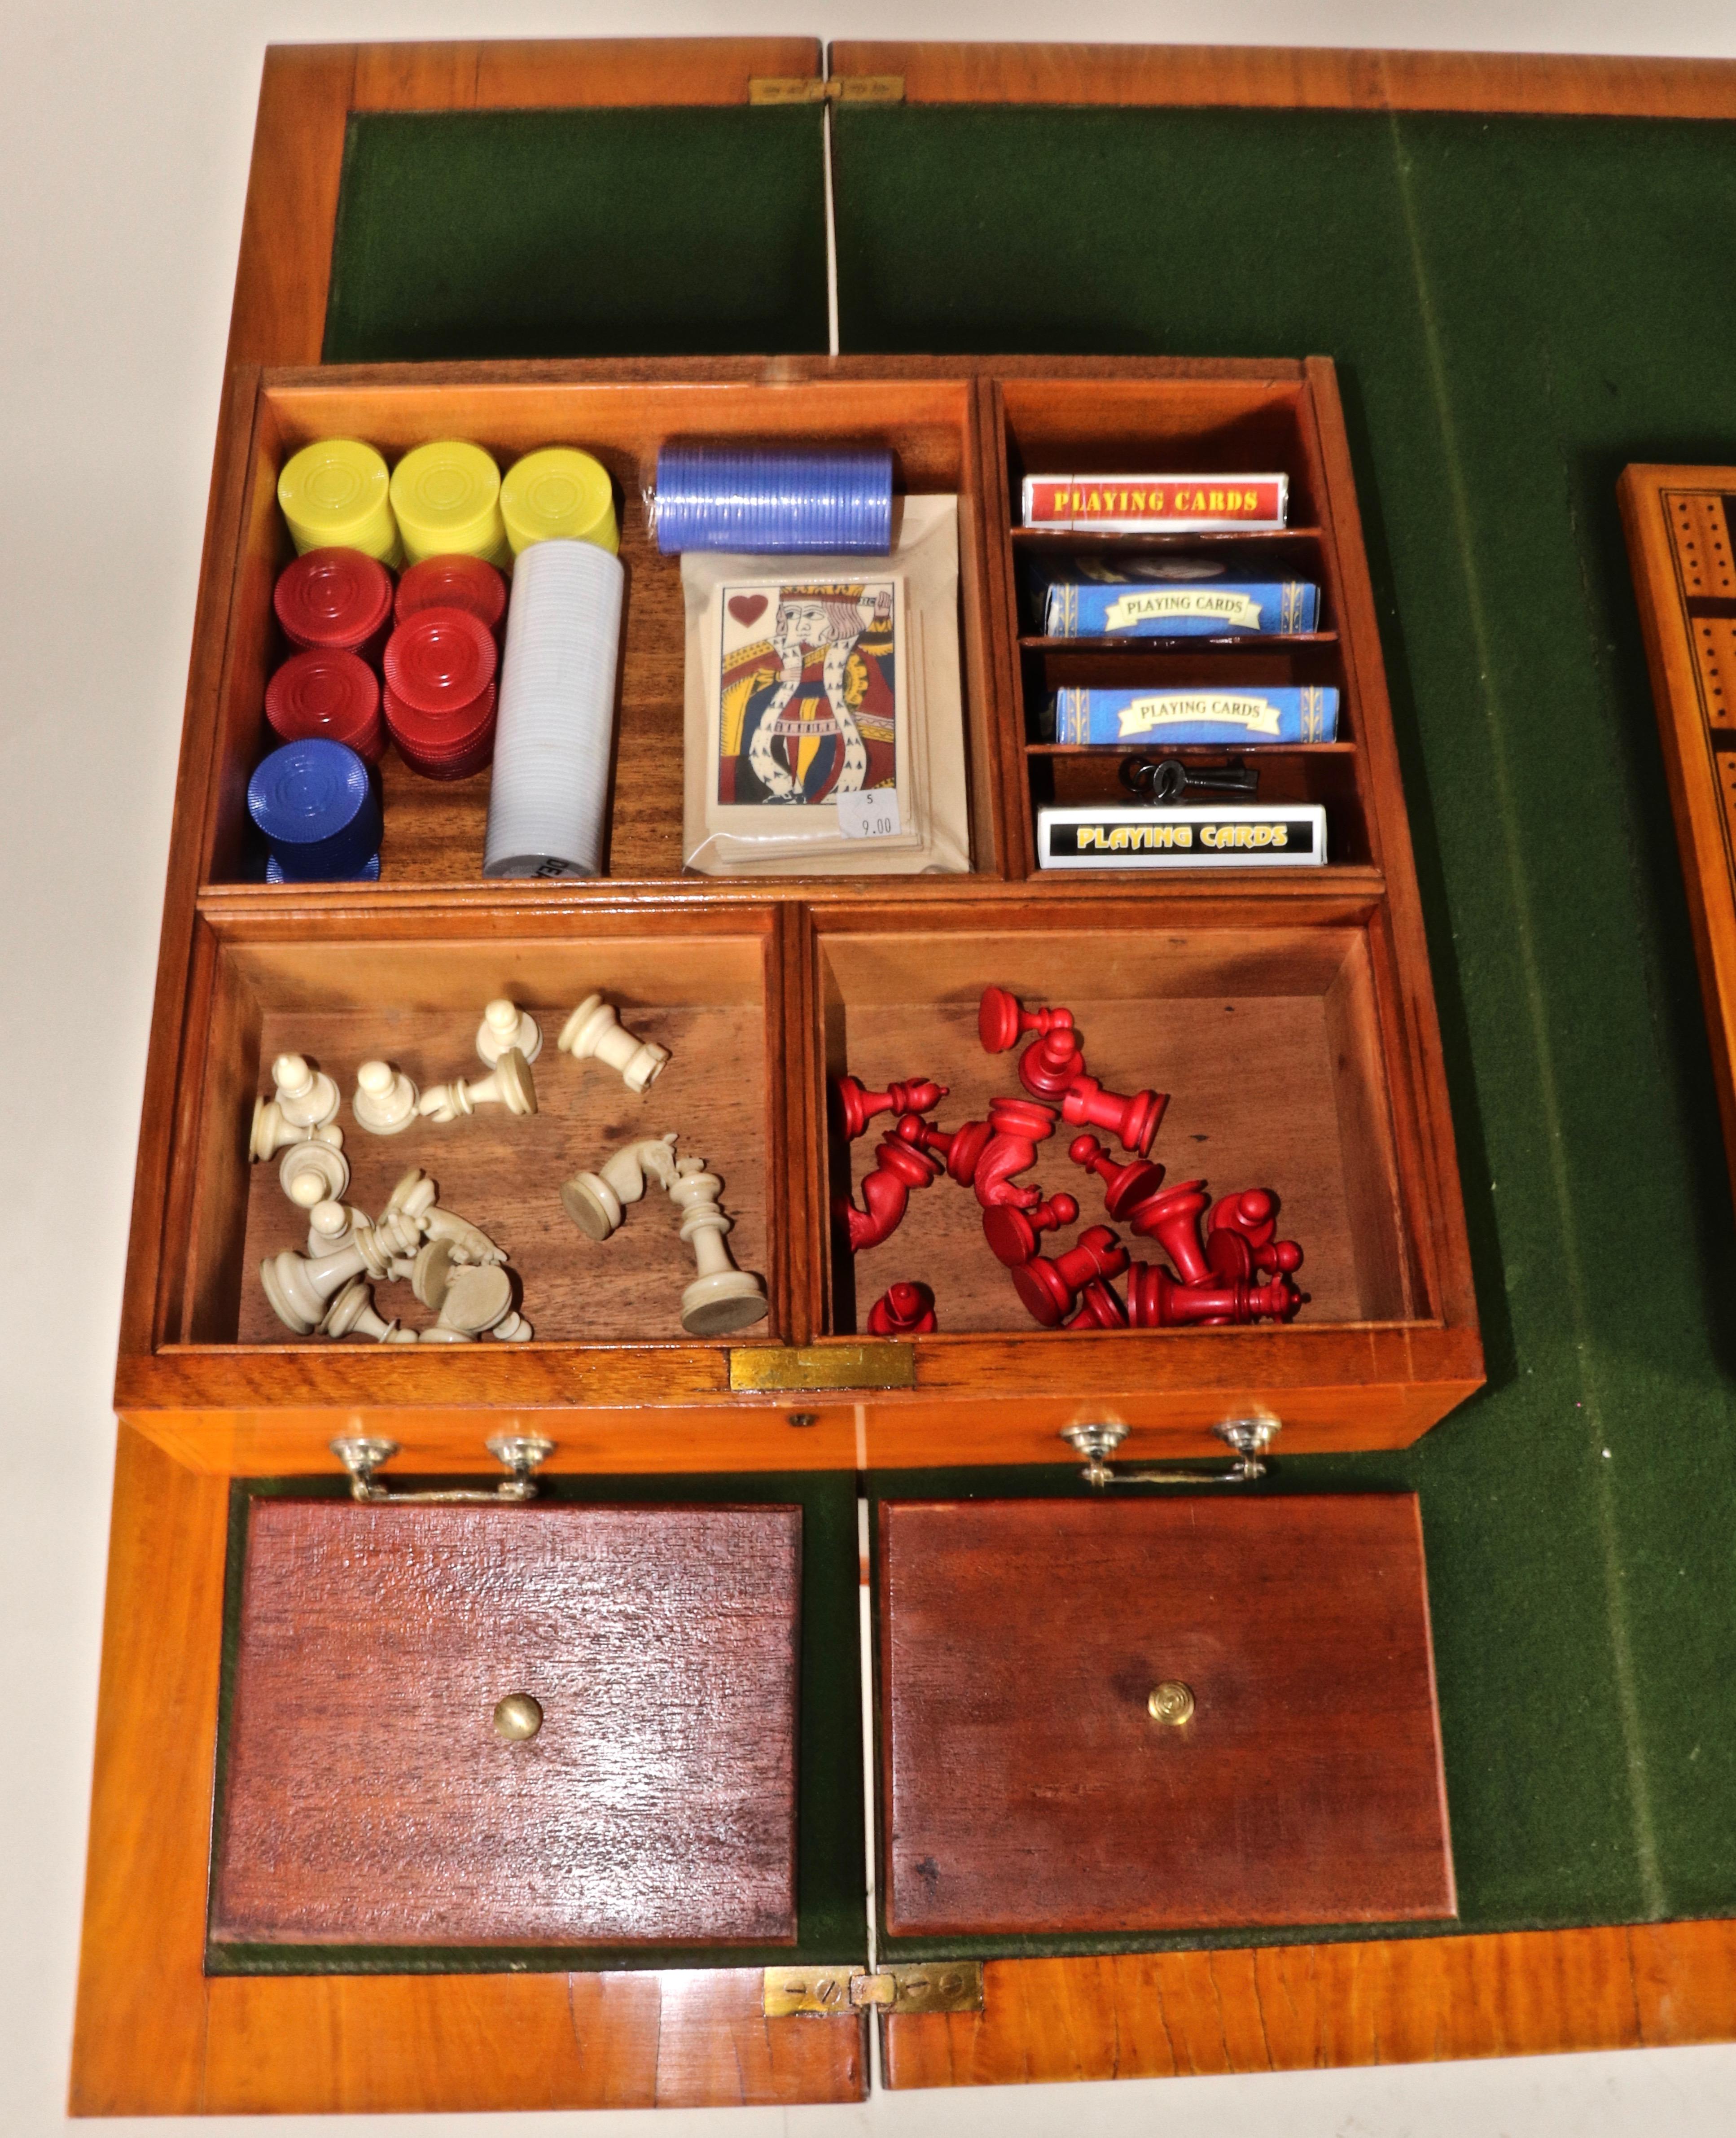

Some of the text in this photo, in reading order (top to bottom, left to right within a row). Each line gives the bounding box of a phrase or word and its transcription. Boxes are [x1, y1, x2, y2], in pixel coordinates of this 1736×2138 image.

[1054, 491, 1258, 511] PLAYING CARDS
[1127, 596, 1243, 614] PLAYING CARDS
[1140, 701, 1261, 719] PLAYING CARDS
[862, 818, 891, 835] 9.00
[1077, 825, 1287, 850] PLAYING CARDS
